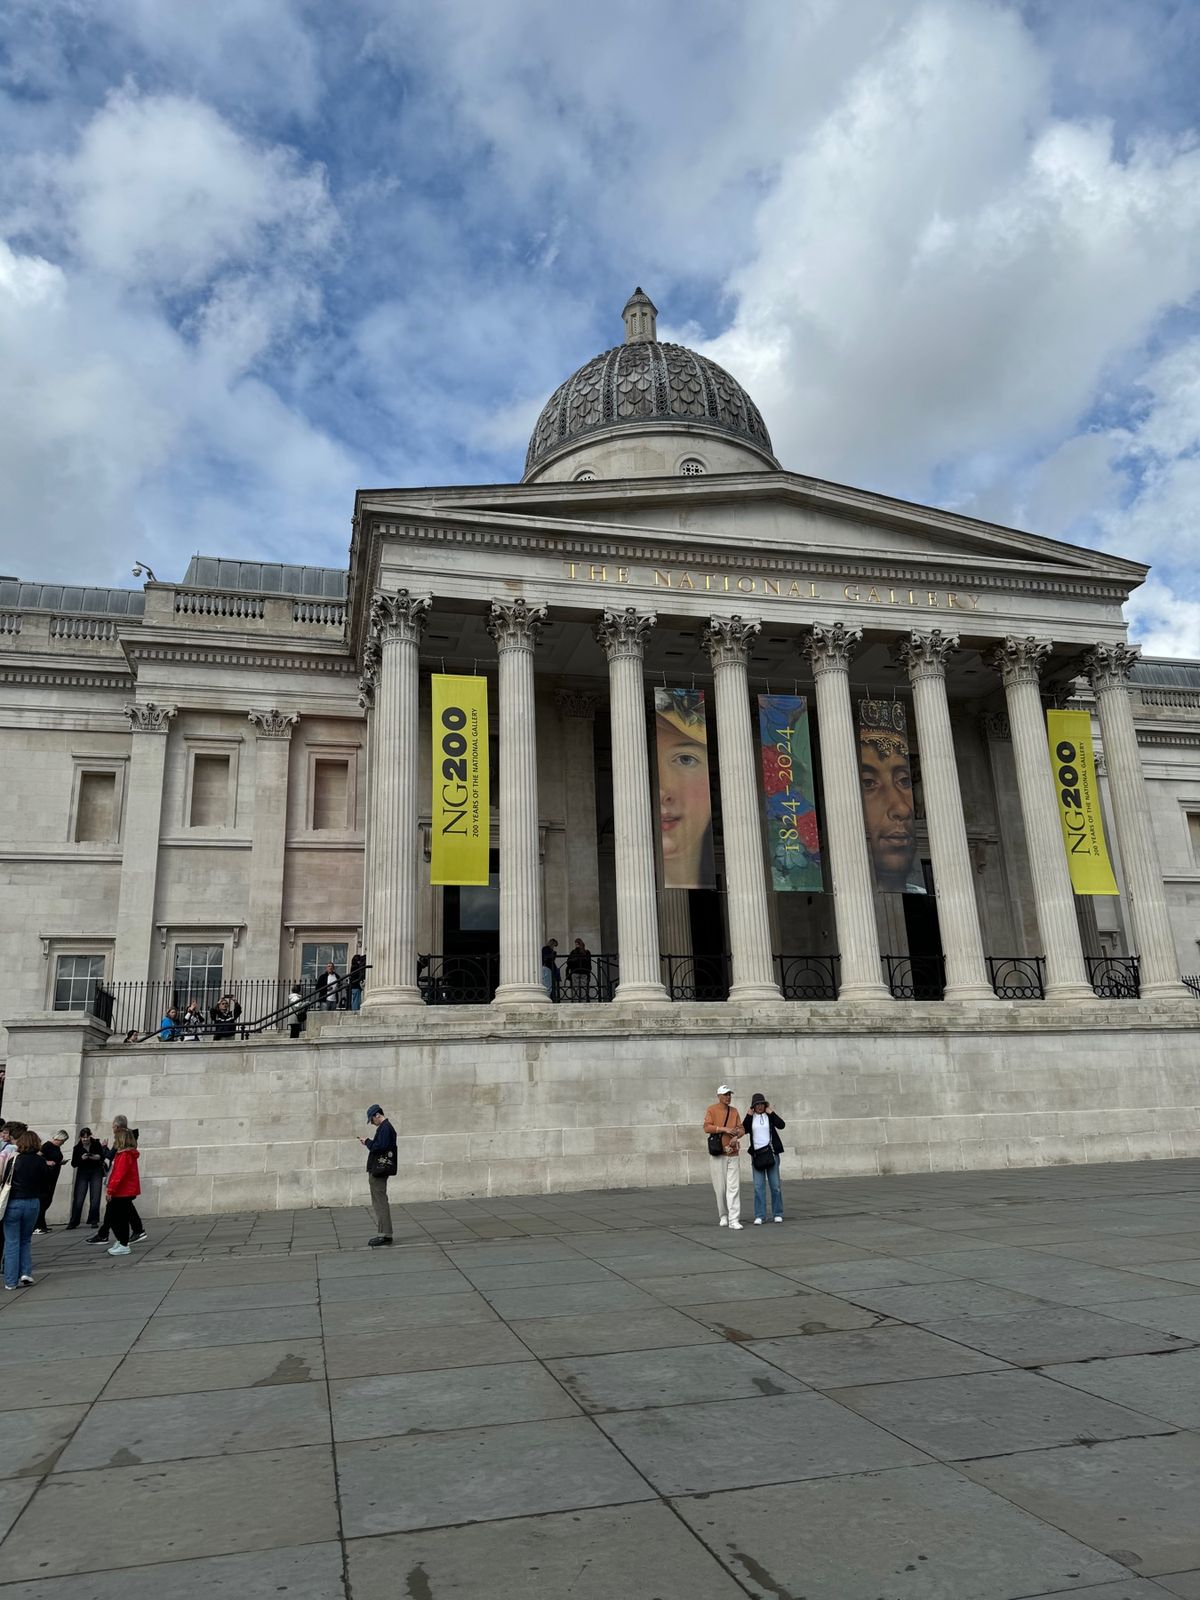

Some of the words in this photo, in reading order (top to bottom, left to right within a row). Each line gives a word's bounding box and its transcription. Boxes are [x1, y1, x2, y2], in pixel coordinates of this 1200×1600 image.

[563, 561, 629, 584] THE
[653, 569, 821, 598] NATIONAL
[844, 584, 982, 610] GALLERY
[441, 706, 468, 836] NG200
[472, 788, 479, 799] OF
[1056, 740, 1091, 856] NG200
[1089, 824, 1097, 845] YEARS
